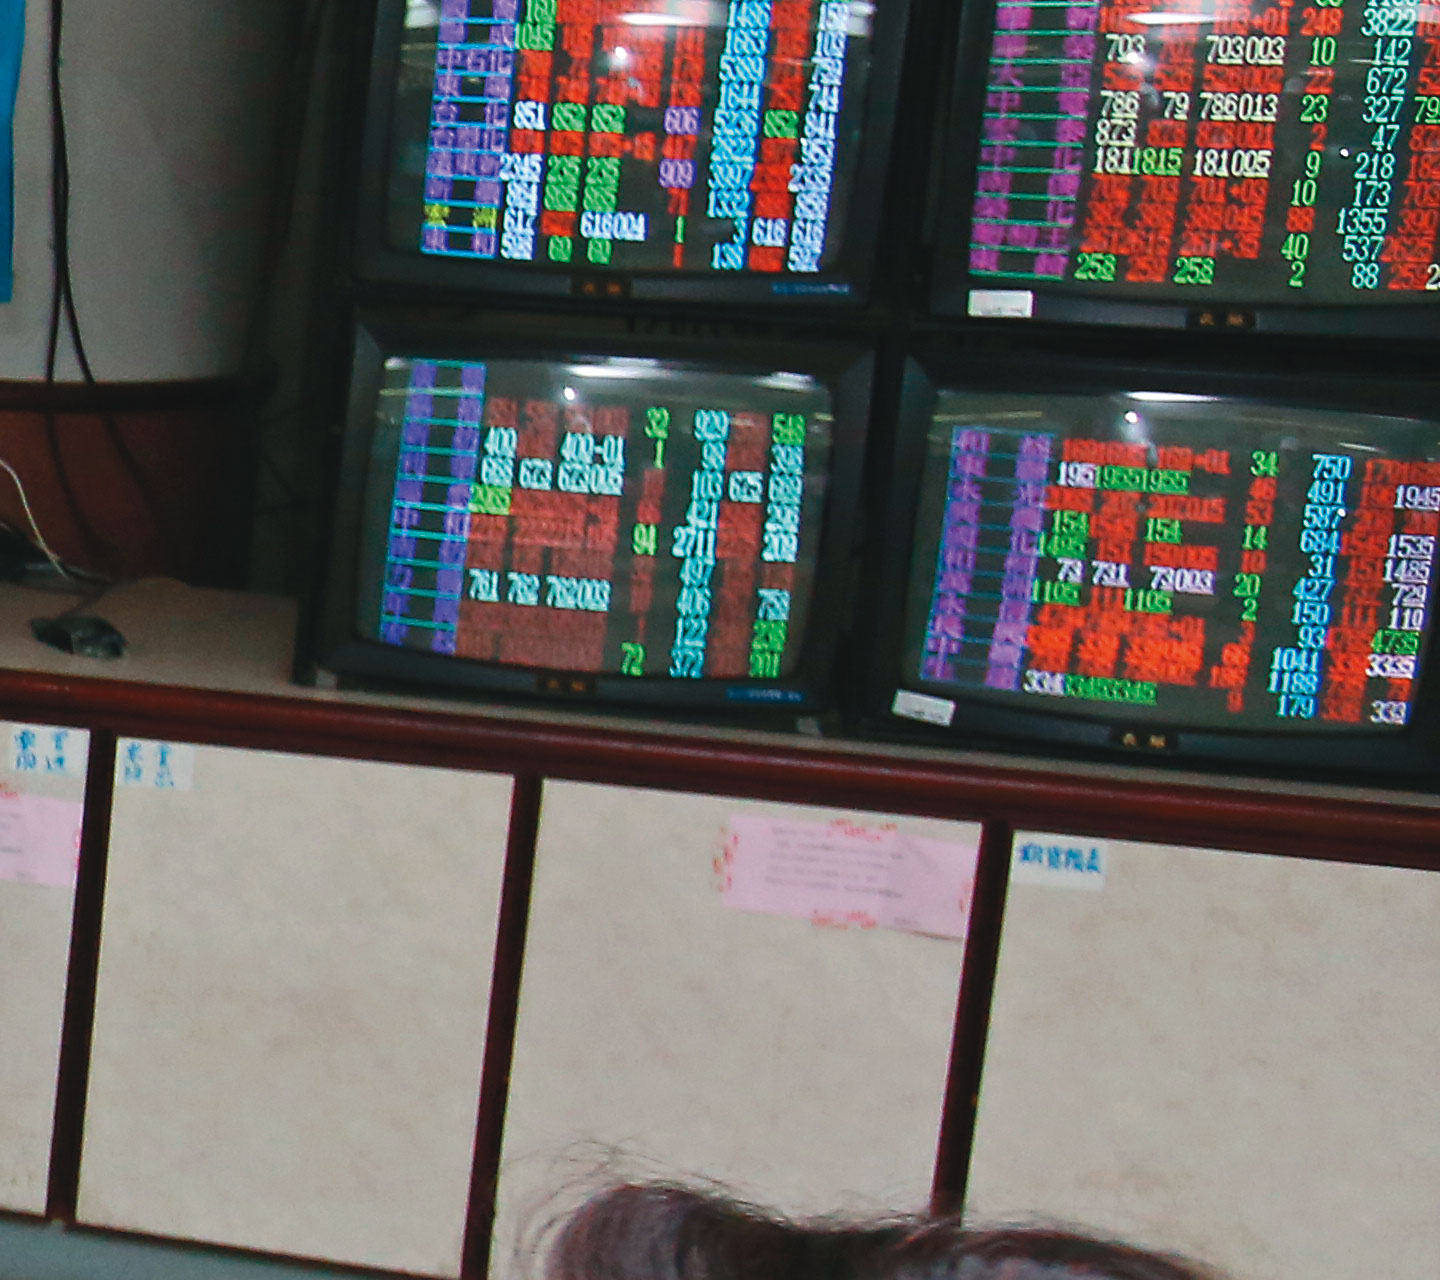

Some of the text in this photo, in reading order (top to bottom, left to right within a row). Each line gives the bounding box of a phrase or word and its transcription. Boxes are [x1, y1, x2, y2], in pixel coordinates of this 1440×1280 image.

[1361, 6, 1416, 36] 3822
[1309, 36, 1335, 66] 10
[1371, 37, 1411, 66] 142
[1366, 67, 1408, 95] 672
[1100, 90, 1403, 123] 786 79 23 327
[1096, 119, 1399, 150] 873 47
[1354, 152, 1395, 180] 218
[1291, 178, 1390, 207] 10 173
[1336, 207, 1387, 236] 1355
[1282, 233, 1384, 262] 40 537
[1351, 263, 1379, 290] 88
